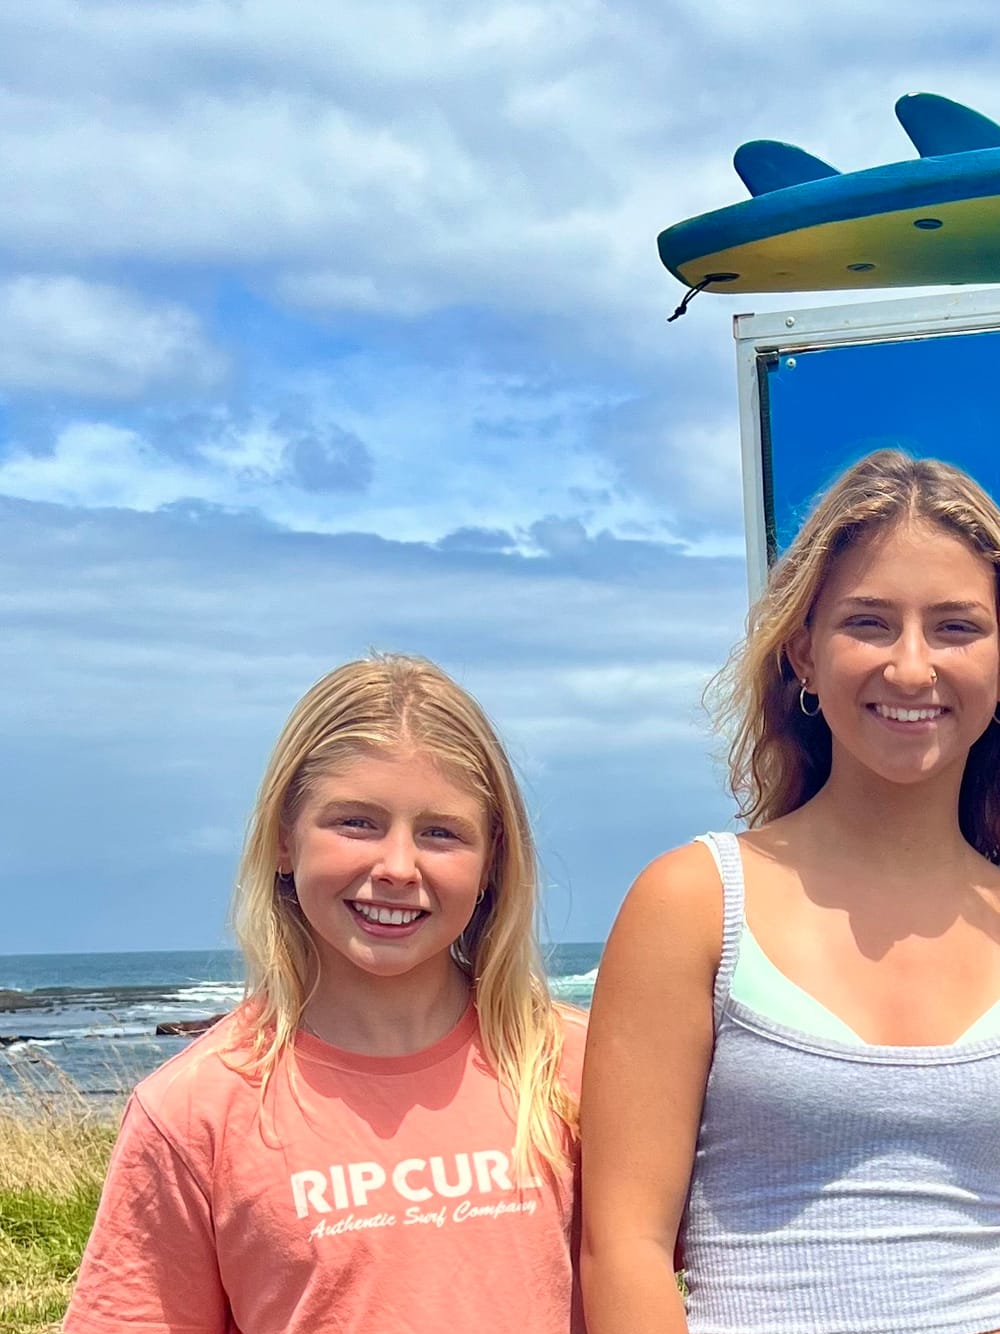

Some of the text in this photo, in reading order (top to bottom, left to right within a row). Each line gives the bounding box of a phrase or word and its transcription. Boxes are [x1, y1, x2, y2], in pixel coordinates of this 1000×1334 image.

[290, 1161, 387, 1219] RIP
[308, 1200, 537, 1242] Authentic Surf Company
